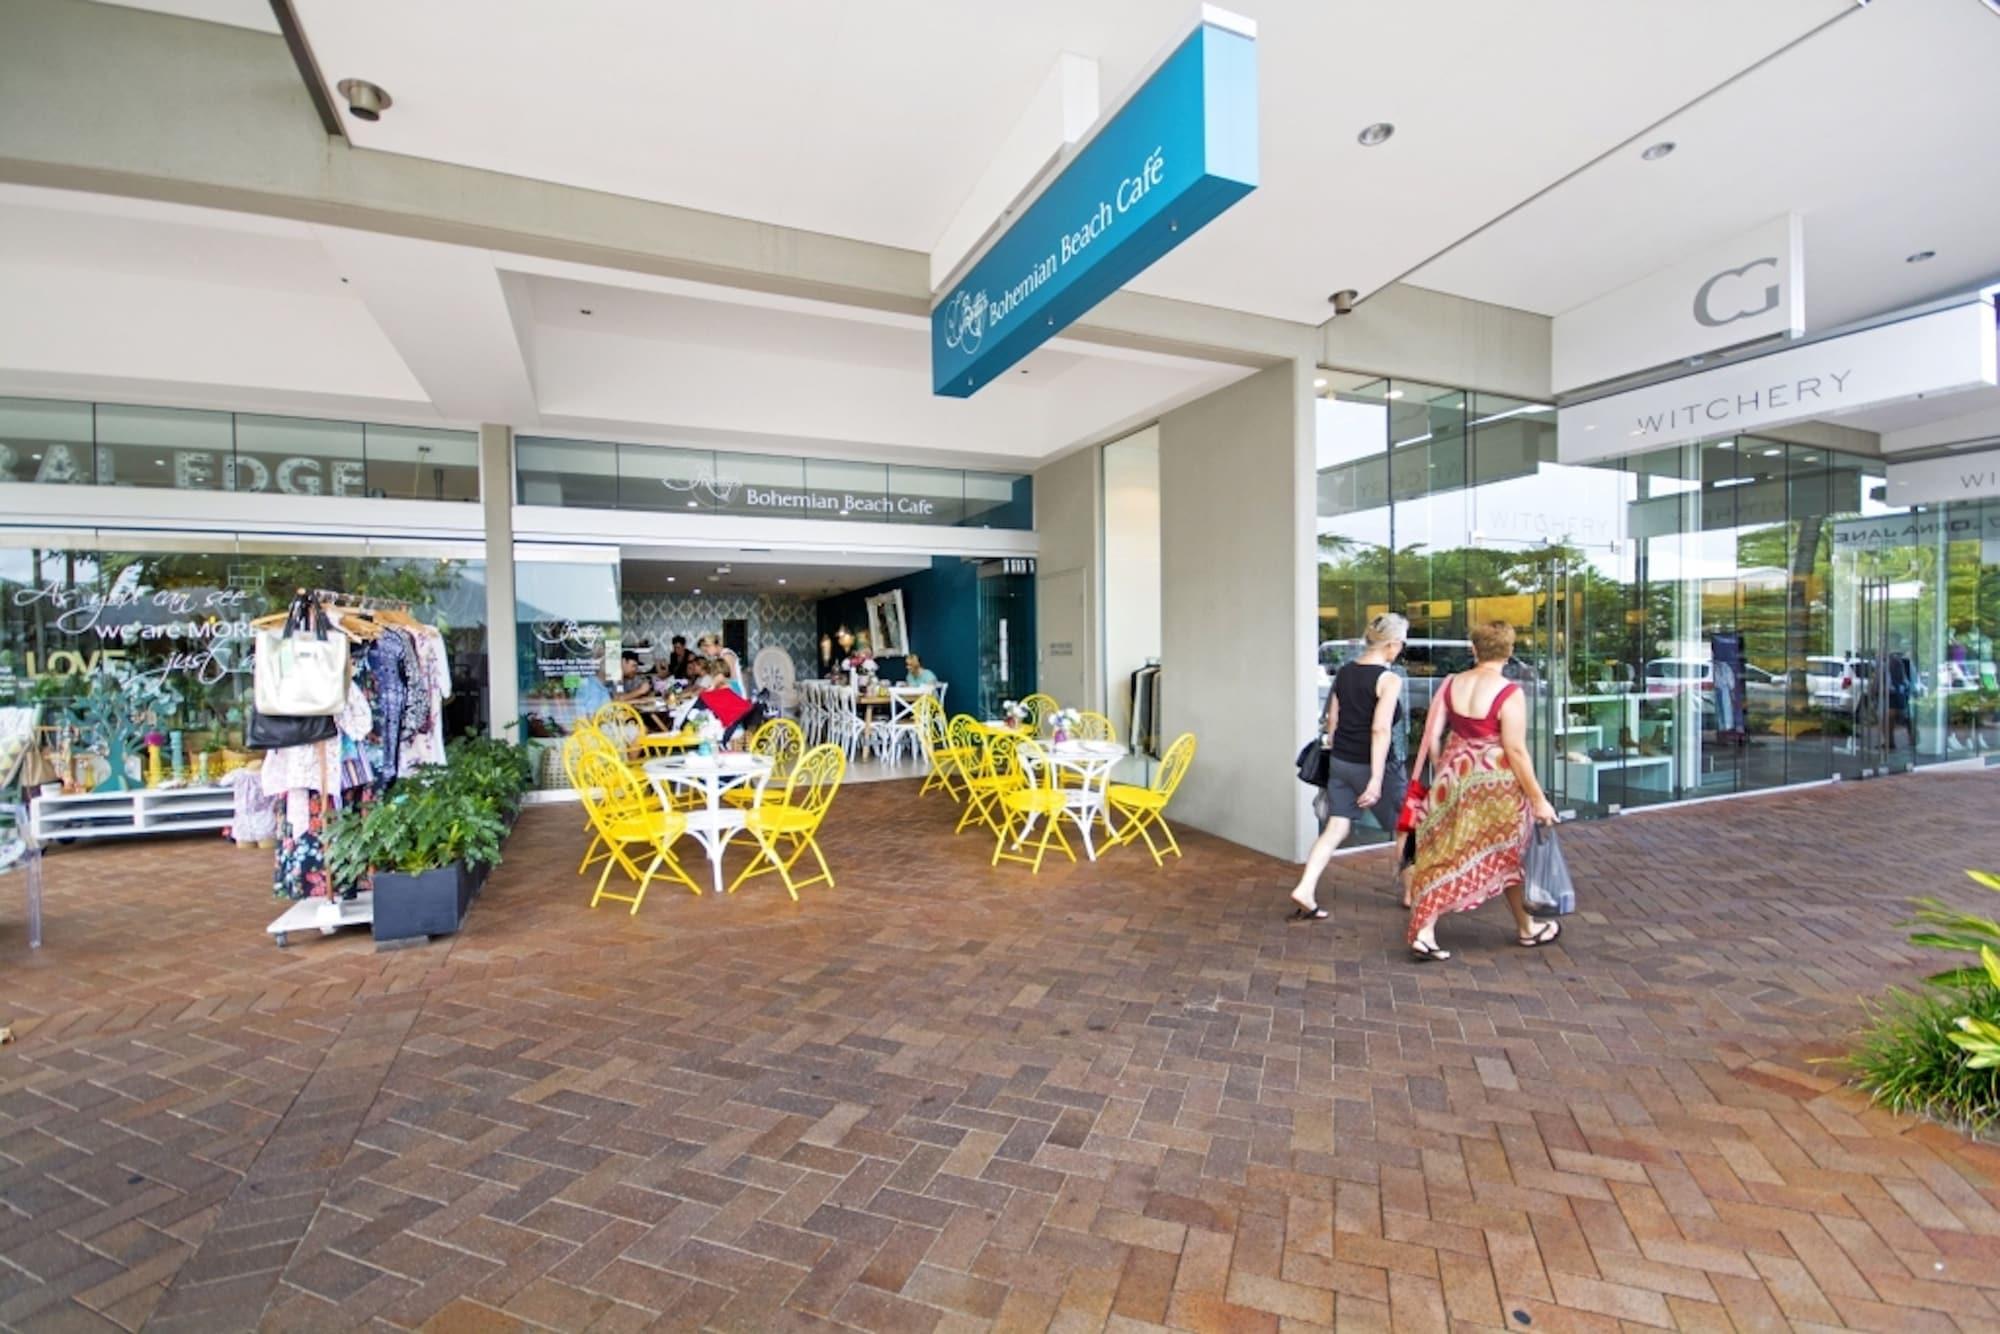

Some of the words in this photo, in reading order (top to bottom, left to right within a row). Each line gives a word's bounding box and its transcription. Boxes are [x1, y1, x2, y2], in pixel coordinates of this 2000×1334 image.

[989, 253, 1057, 327] Bohemian
[1061, 202, 1113, 264] Beach
[1116, 145, 1164, 213] Café
[1637, 369, 1852, 435] WITCHERY
[173, 449, 367, 498] EDGE
[746, 489, 839, 510] Bohemian
[844, 494, 893, 513] Beach
[897, 498, 934, 515] Cafe
[95, 622, 134, 640] we
[141, 622, 183, 640] are
